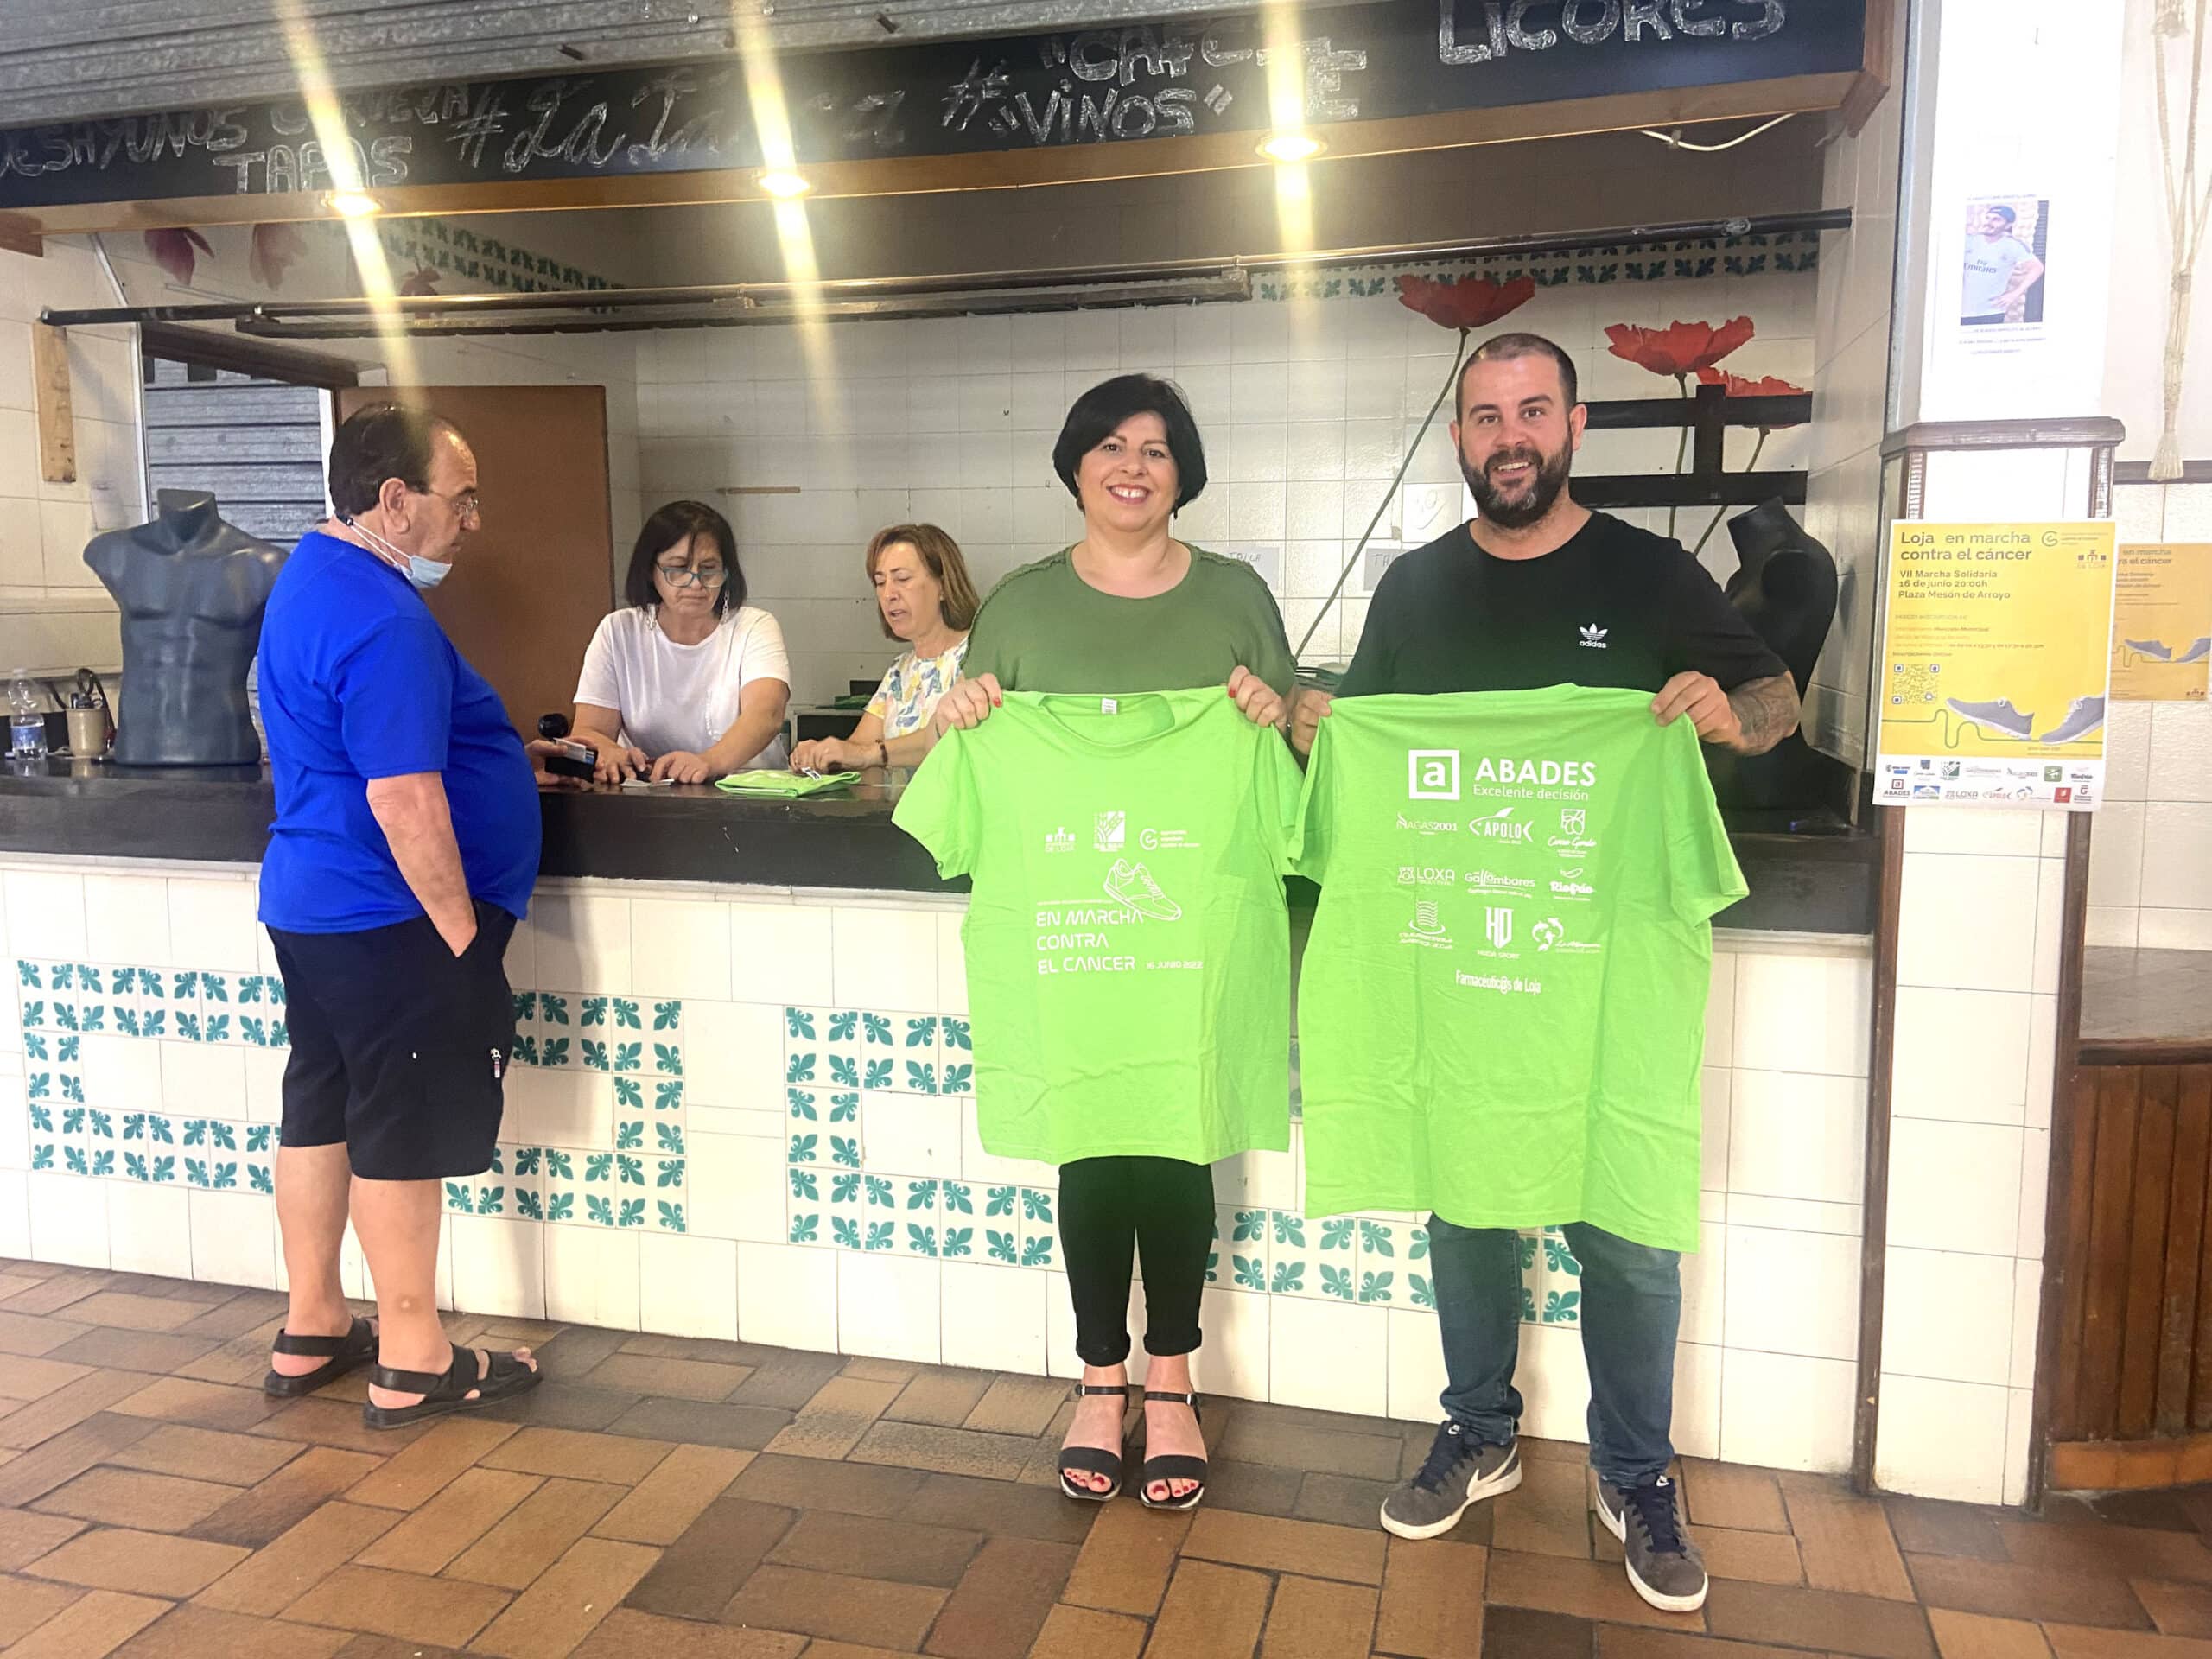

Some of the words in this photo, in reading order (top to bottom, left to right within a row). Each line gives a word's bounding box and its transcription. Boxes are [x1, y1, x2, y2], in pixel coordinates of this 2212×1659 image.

[1901, 531, 1935, 546] Loja
[1945, 533, 1964, 543] en
[1969, 531, 2031, 544] marcha
[1900, 548, 1952, 561] contra
[1956, 548, 1972, 560] el
[1975, 548, 2032, 561] cáncer
[1915, 569, 1951, 578] Marcha
[1954, 569, 1998, 578] Solidaria
[1926, 580, 1952, 589] junio
[1898, 590, 1925, 599] Plaza
[1962, 590, 1975, 599] de
[1977, 590, 2011, 601] Arroyo
[1579, 640, 1607, 649] adidas
[1474, 757, 1597, 787] ABADES
[1473, 784, 1534, 799] Excelente
[1536, 787, 1589, 802] decisión
[1484, 821, 1522, 839] APOLO
[1416, 867, 1455, 882] LOXA
[1036, 912, 1061, 927] EN
[1065, 908, 1144, 926] MARCHA
[1036, 932, 1109, 951] CONTRA
[1038, 958, 1059, 975] EL
[1063, 956, 1136, 973] CANCER
